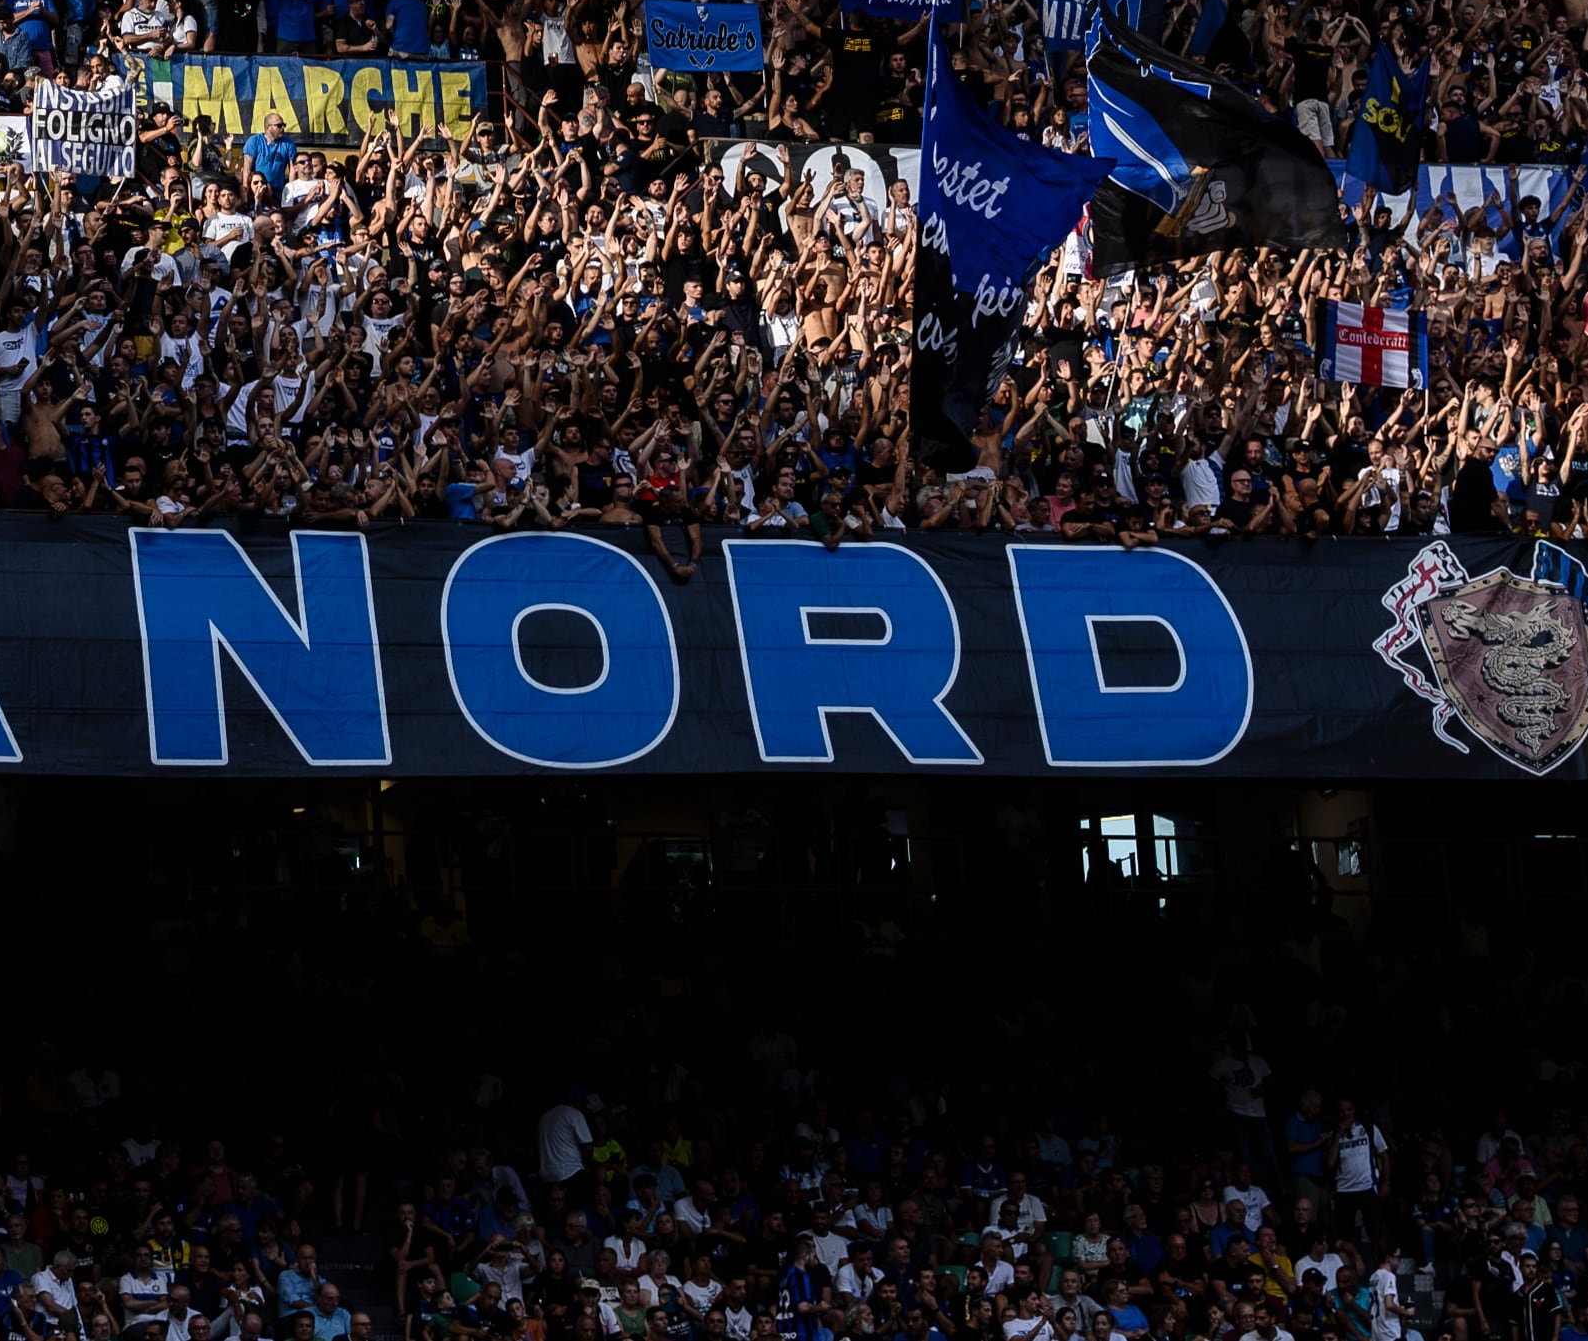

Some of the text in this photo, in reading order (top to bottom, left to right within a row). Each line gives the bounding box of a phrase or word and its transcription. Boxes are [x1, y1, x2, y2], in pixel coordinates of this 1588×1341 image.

[34, 108, 136, 146] FOLIGNO
[181, 64, 472, 142] MARCHE
[126, 522, 1260, 772] NORD
